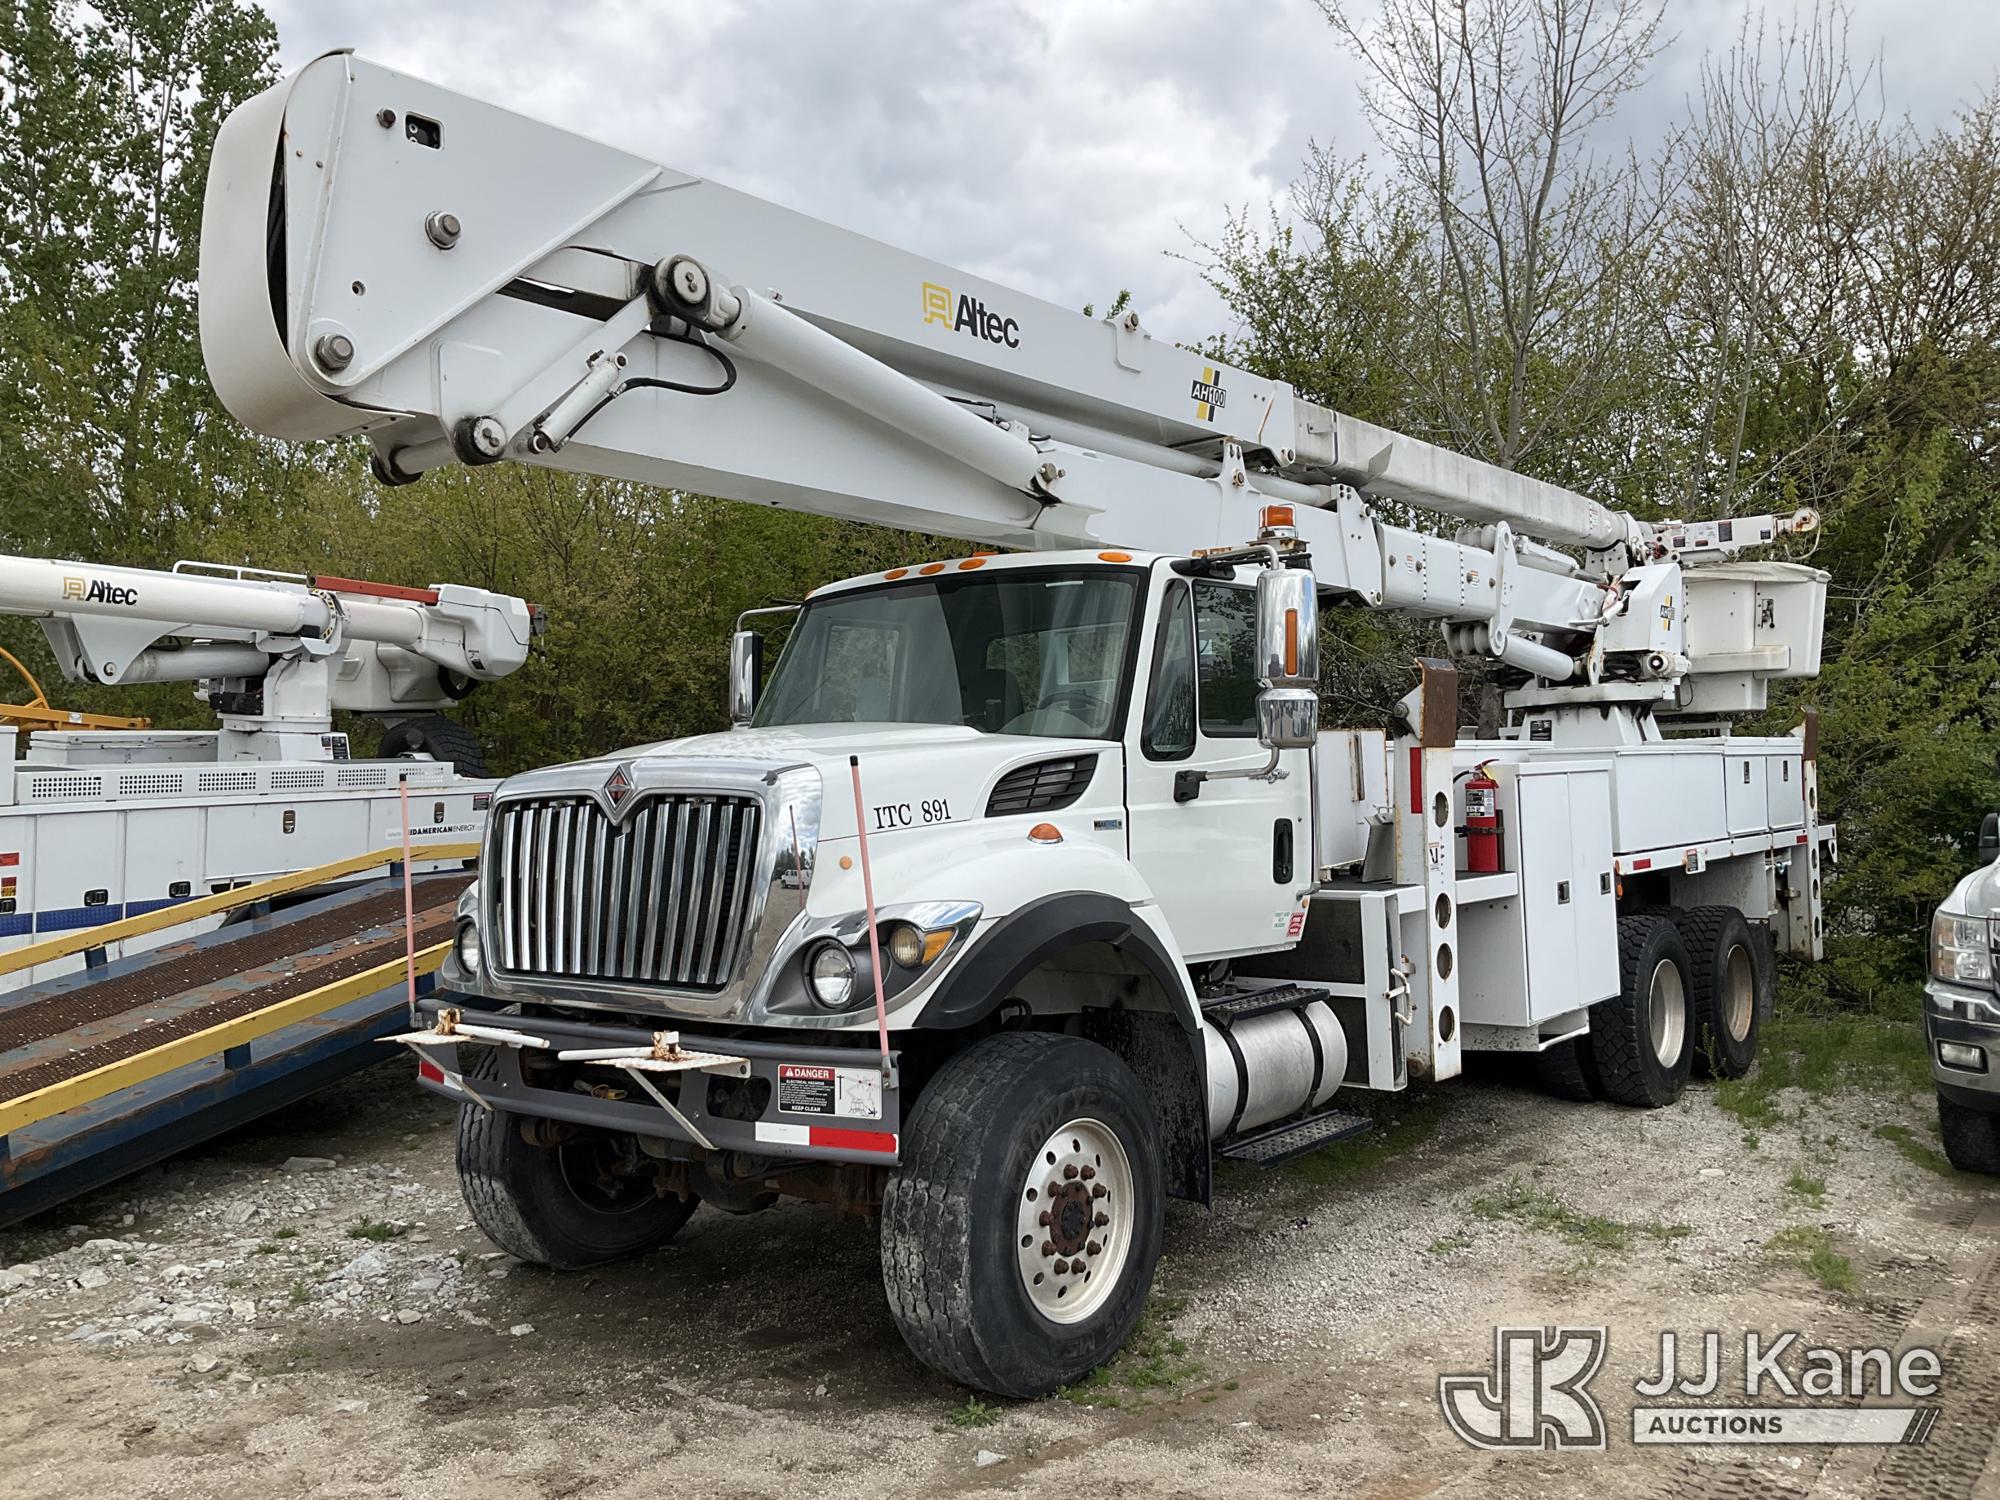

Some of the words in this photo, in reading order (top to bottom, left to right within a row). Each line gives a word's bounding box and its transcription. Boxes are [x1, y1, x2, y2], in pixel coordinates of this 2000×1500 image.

[954, 294, 1020, 348] Altec
[1192, 382, 1226, 407] AH100
[85, 579, 138, 605] Altec
[873, 803, 912, 829] ITC
[921, 798, 951, 822] 891
[794, 1068, 829, 1079] DANGER
